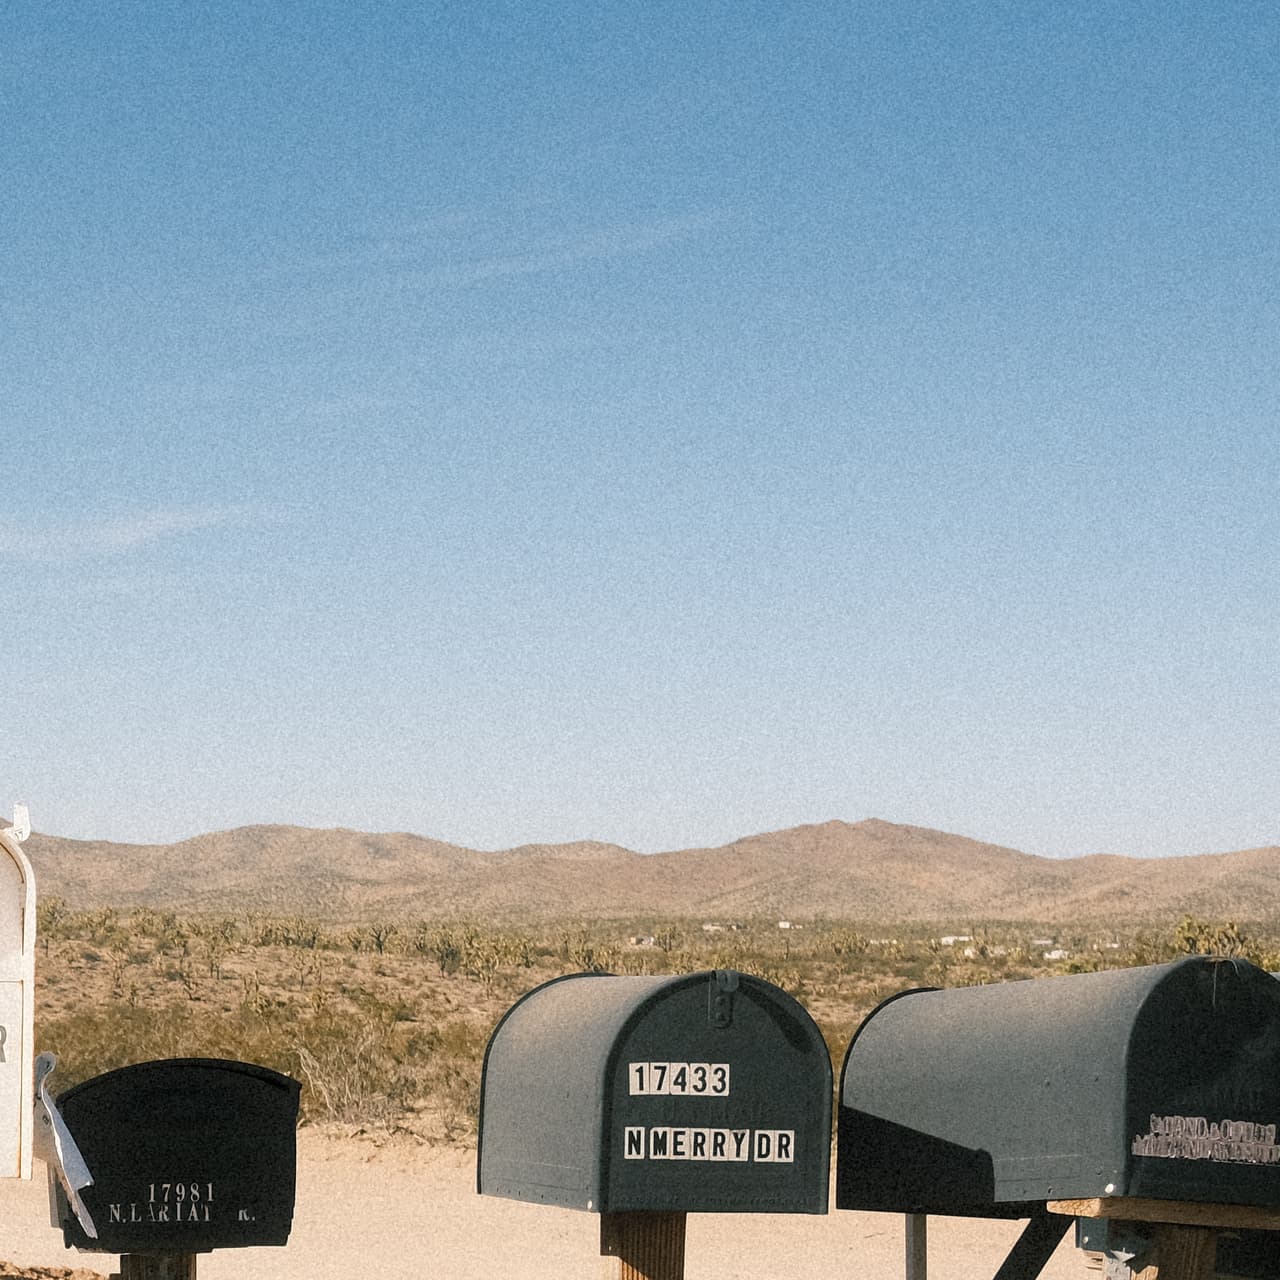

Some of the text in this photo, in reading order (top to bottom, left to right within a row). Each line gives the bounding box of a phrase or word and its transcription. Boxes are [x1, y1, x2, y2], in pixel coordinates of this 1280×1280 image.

[635, 1065, 727, 1093] 17433
[627, 1130, 791, 1159] N MERRY DR
[148, 1182, 214, 1202] 17981
